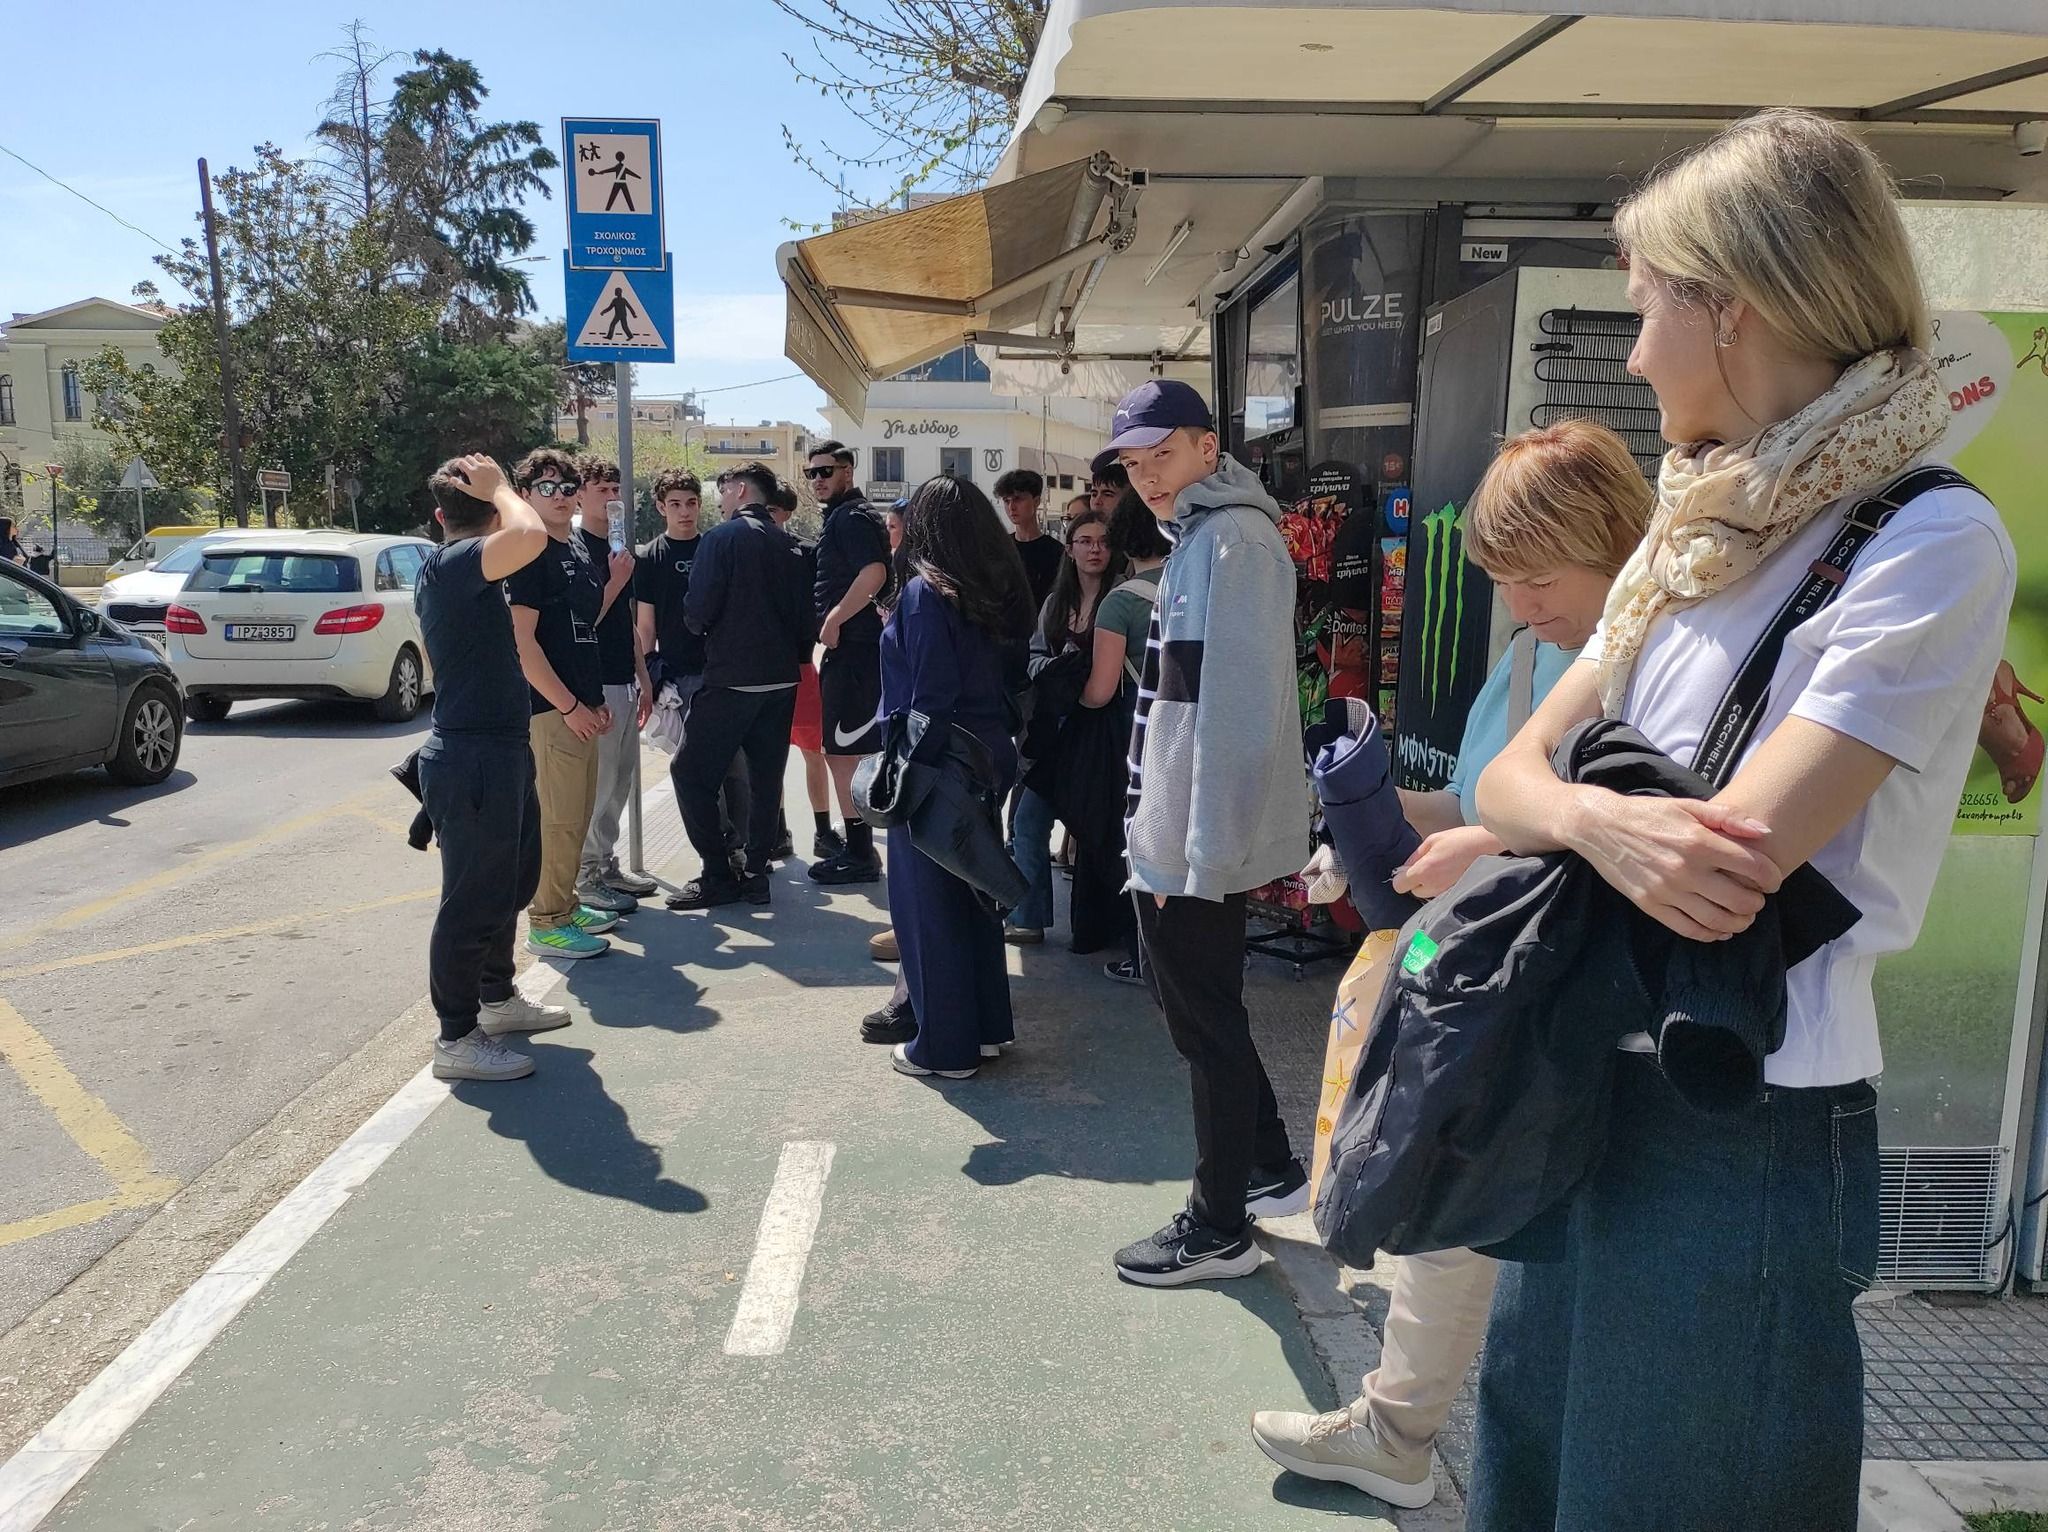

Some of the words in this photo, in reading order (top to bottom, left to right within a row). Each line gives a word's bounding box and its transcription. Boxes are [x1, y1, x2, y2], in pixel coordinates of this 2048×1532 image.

[594, 231, 637, 241] ΣΧΟΛΙΚΟΣ
[585, 246, 647, 256] ΤΡΟΧΟΝΟΜΟΣ
[1471, 246, 1503, 260] New
[1320, 292, 1403, 327] PULZE
[1356, 321, 1376, 332] YOU
[1378, 320, 1402, 330] NEED
[908, 423, 918, 435] &
[1310, 482, 1351, 494] τρίγωνα
[238, 627, 258, 638] IPZ
[263, 626, 293, 638] 3851
[1332, 619, 1368, 635] Doritos
